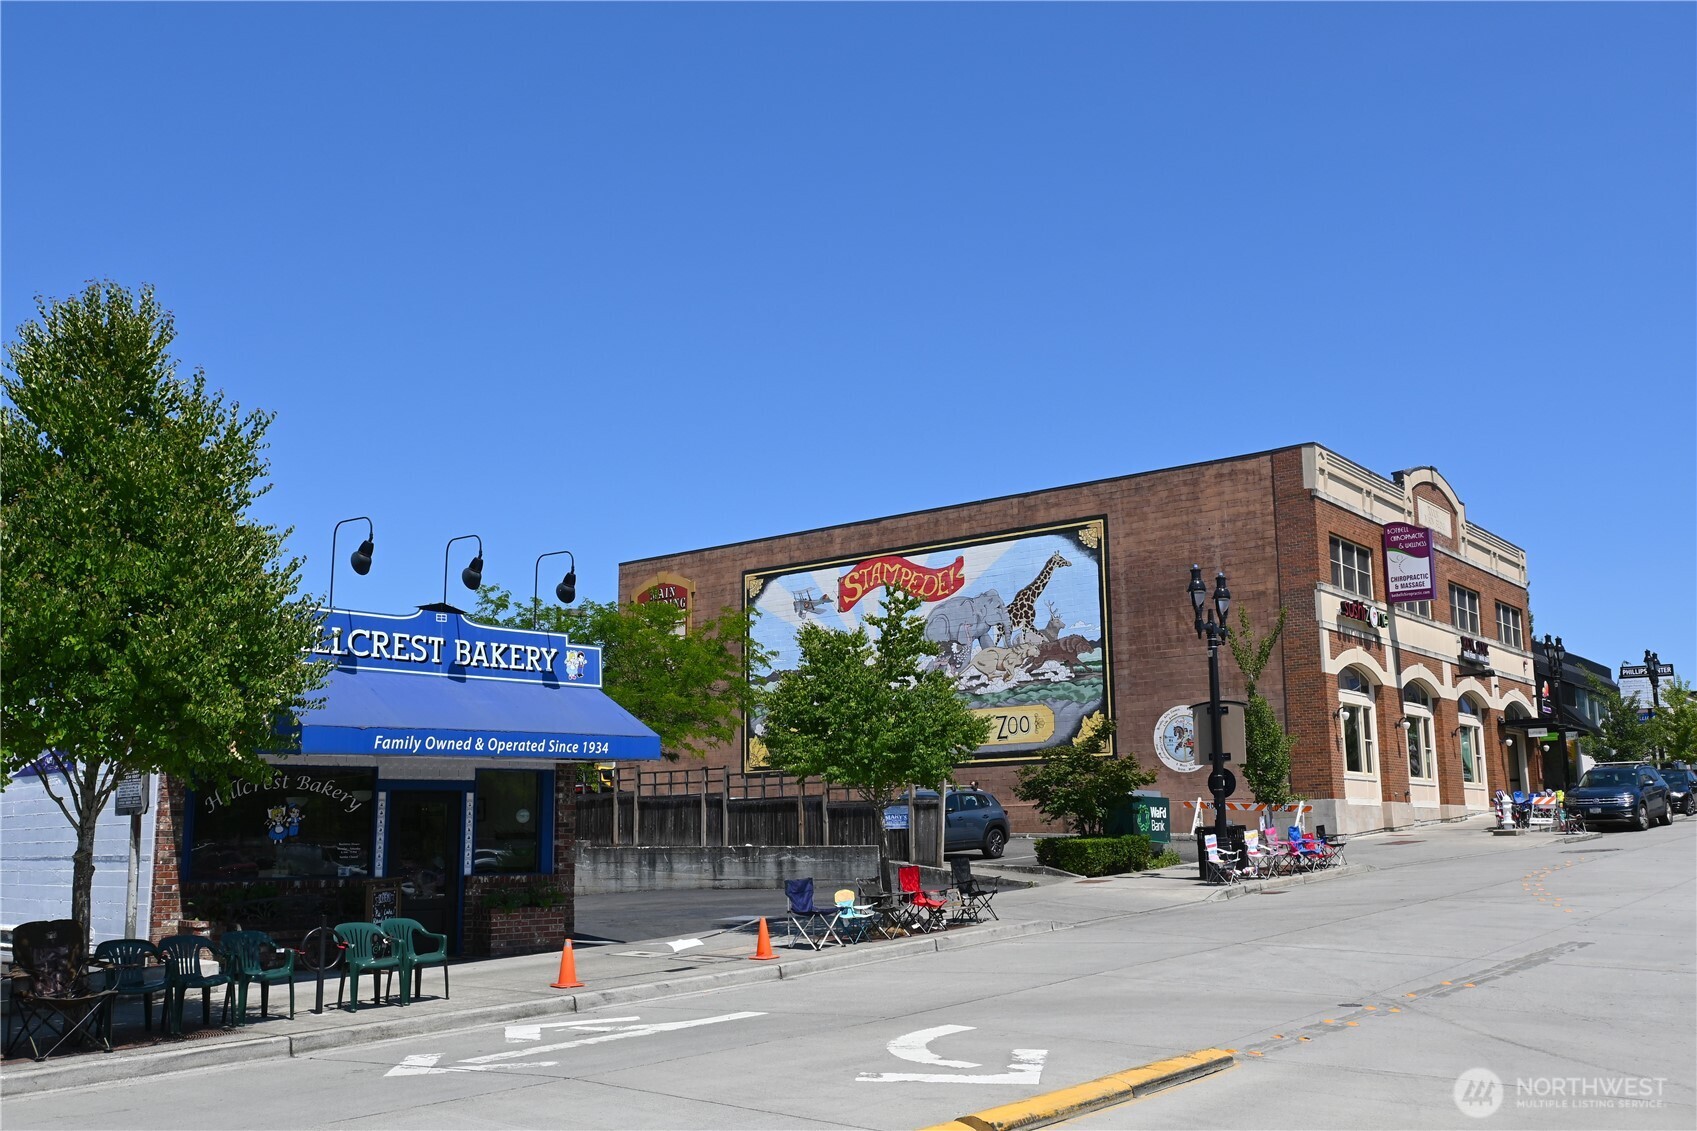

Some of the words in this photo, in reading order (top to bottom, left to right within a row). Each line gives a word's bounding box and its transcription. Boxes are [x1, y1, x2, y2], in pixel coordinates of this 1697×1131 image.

[1387, 527, 1409, 535] BOTHELL
[1390, 532, 1425, 542] CHIROPRACTIC
[1404, 541, 1427, 549] WELLNESS
[843, 562, 955, 603] STAMPEDE!
[1390, 573, 1429, 583] CHIROPRACTIC
[1400, 581, 1425, 589] MASSAGE
[454, 638, 558, 672] BAKERY
[374, 735, 422, 753] Family
[425, 736, 472, 751] Owned
[475, 737, 484, 751] &
[487, 737, 545, 754] Operated
[548, 739, 579, 753] Since
[583, 741, 609, 754] 1934
[204, 775, 290, 814] Hllcrest
[296, 775, 362, 813] Bakery
[1150, 806, 1167, 818] WaFd
[1151, 819, 1165, 831] Bank
